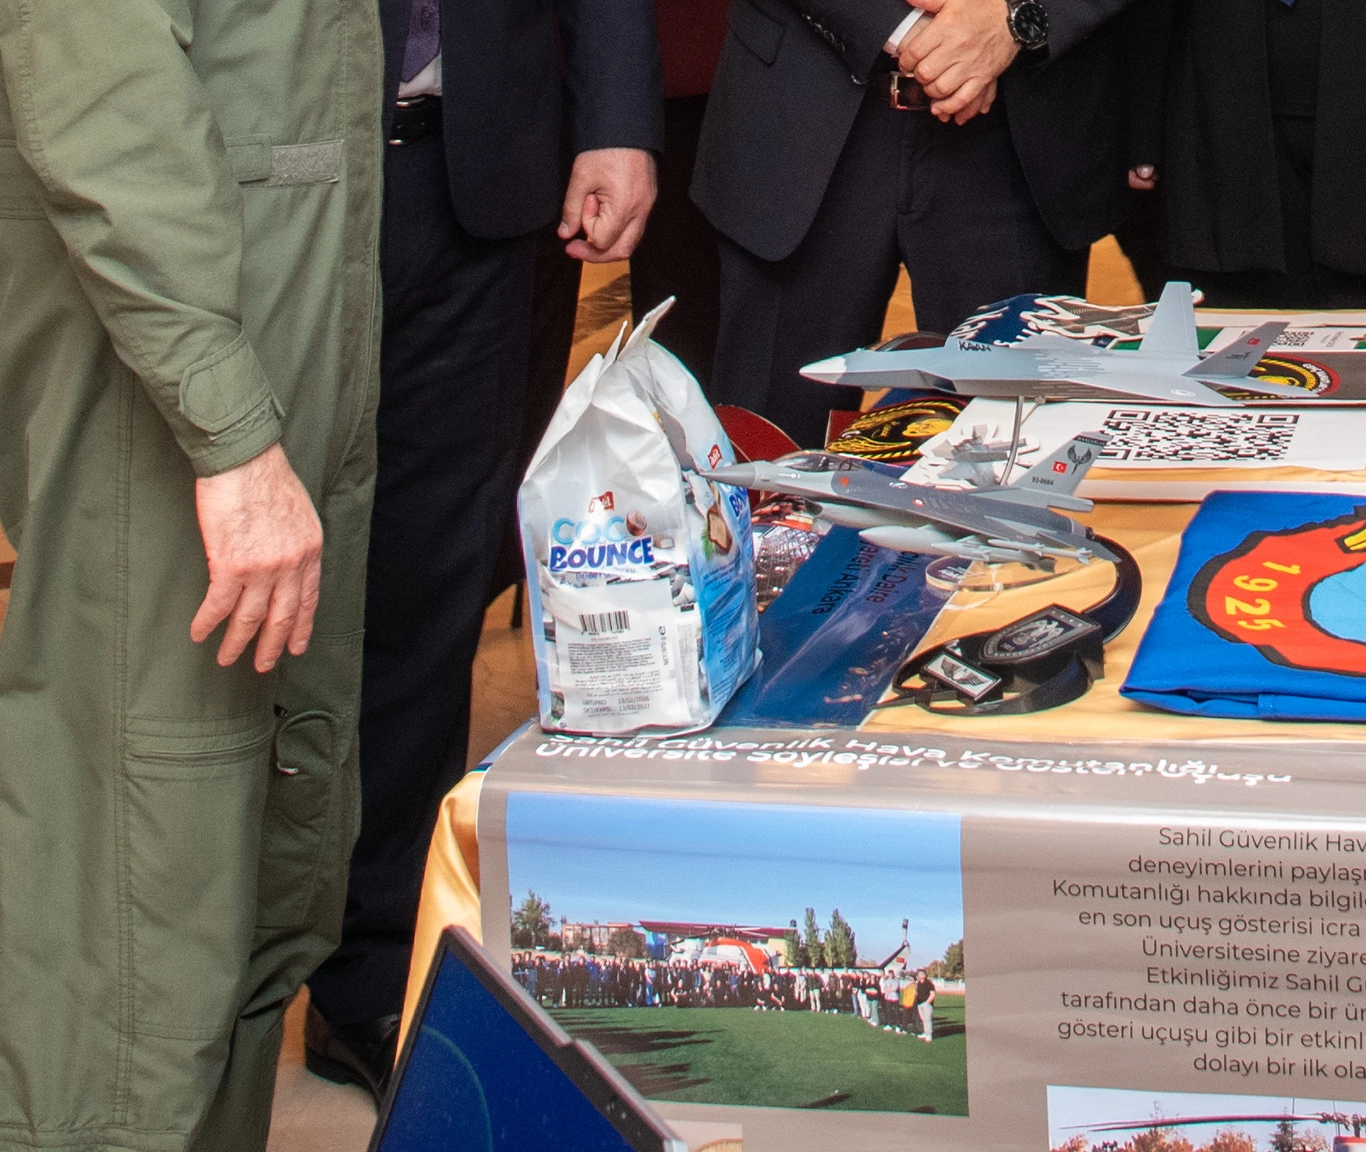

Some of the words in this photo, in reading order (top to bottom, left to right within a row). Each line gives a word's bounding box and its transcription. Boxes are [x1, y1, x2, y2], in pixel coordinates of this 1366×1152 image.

[549, 537, 655, 573] BOUNCE
[1224, 560, 1302, 631] 1925
[535, 742, 737, 763] Üniversite
[655, 737, 836, 751] Güvenlik
[845, 738, 946, 759] Hava
[1159, 827, 1212, 848] Sahil
[1219, 829, 1318, 852] Güvenlik
[1128, 855, 1283, 879] deneyimlerini
[1053, 879, 1190, 905] Komutanlığı
[1197, 884, 1302, 907] hakkında
[1078, 910, 1106, 926] en
[1112, 912, 1152, 928] son
[1159, 913, 1212, 935] uçuş
[1218, 914, 1313, 935] gösterisi
[1320, 917, 1360, 937] icra
[1142, 935, 1300, 963] Üniversitesine
[1146, 966, 1279, 991] Etkinliğimiz
[1285, 972, 1339, 993] Sahil
[1061, 991, 1176, 1013] tarafından
[1183, 996, 1239, 1016] daha
[1246, 999, 1301, 1019] önce
[1309, 1001, 1338, 1020] bir
[1057, 1018, 1134, 1040] gösteri
[1141, 1024, 1208, 1046] uçuşu
[1215, 1026, 1257, 1048] gibi
[1264, 1027, 1294, 1047] bir
[1193, 1053, 1259, 1076] dolayı
[1267, 1056, 1296, 1075] bir
[1303, 1058, 1328, 1077] ilk
